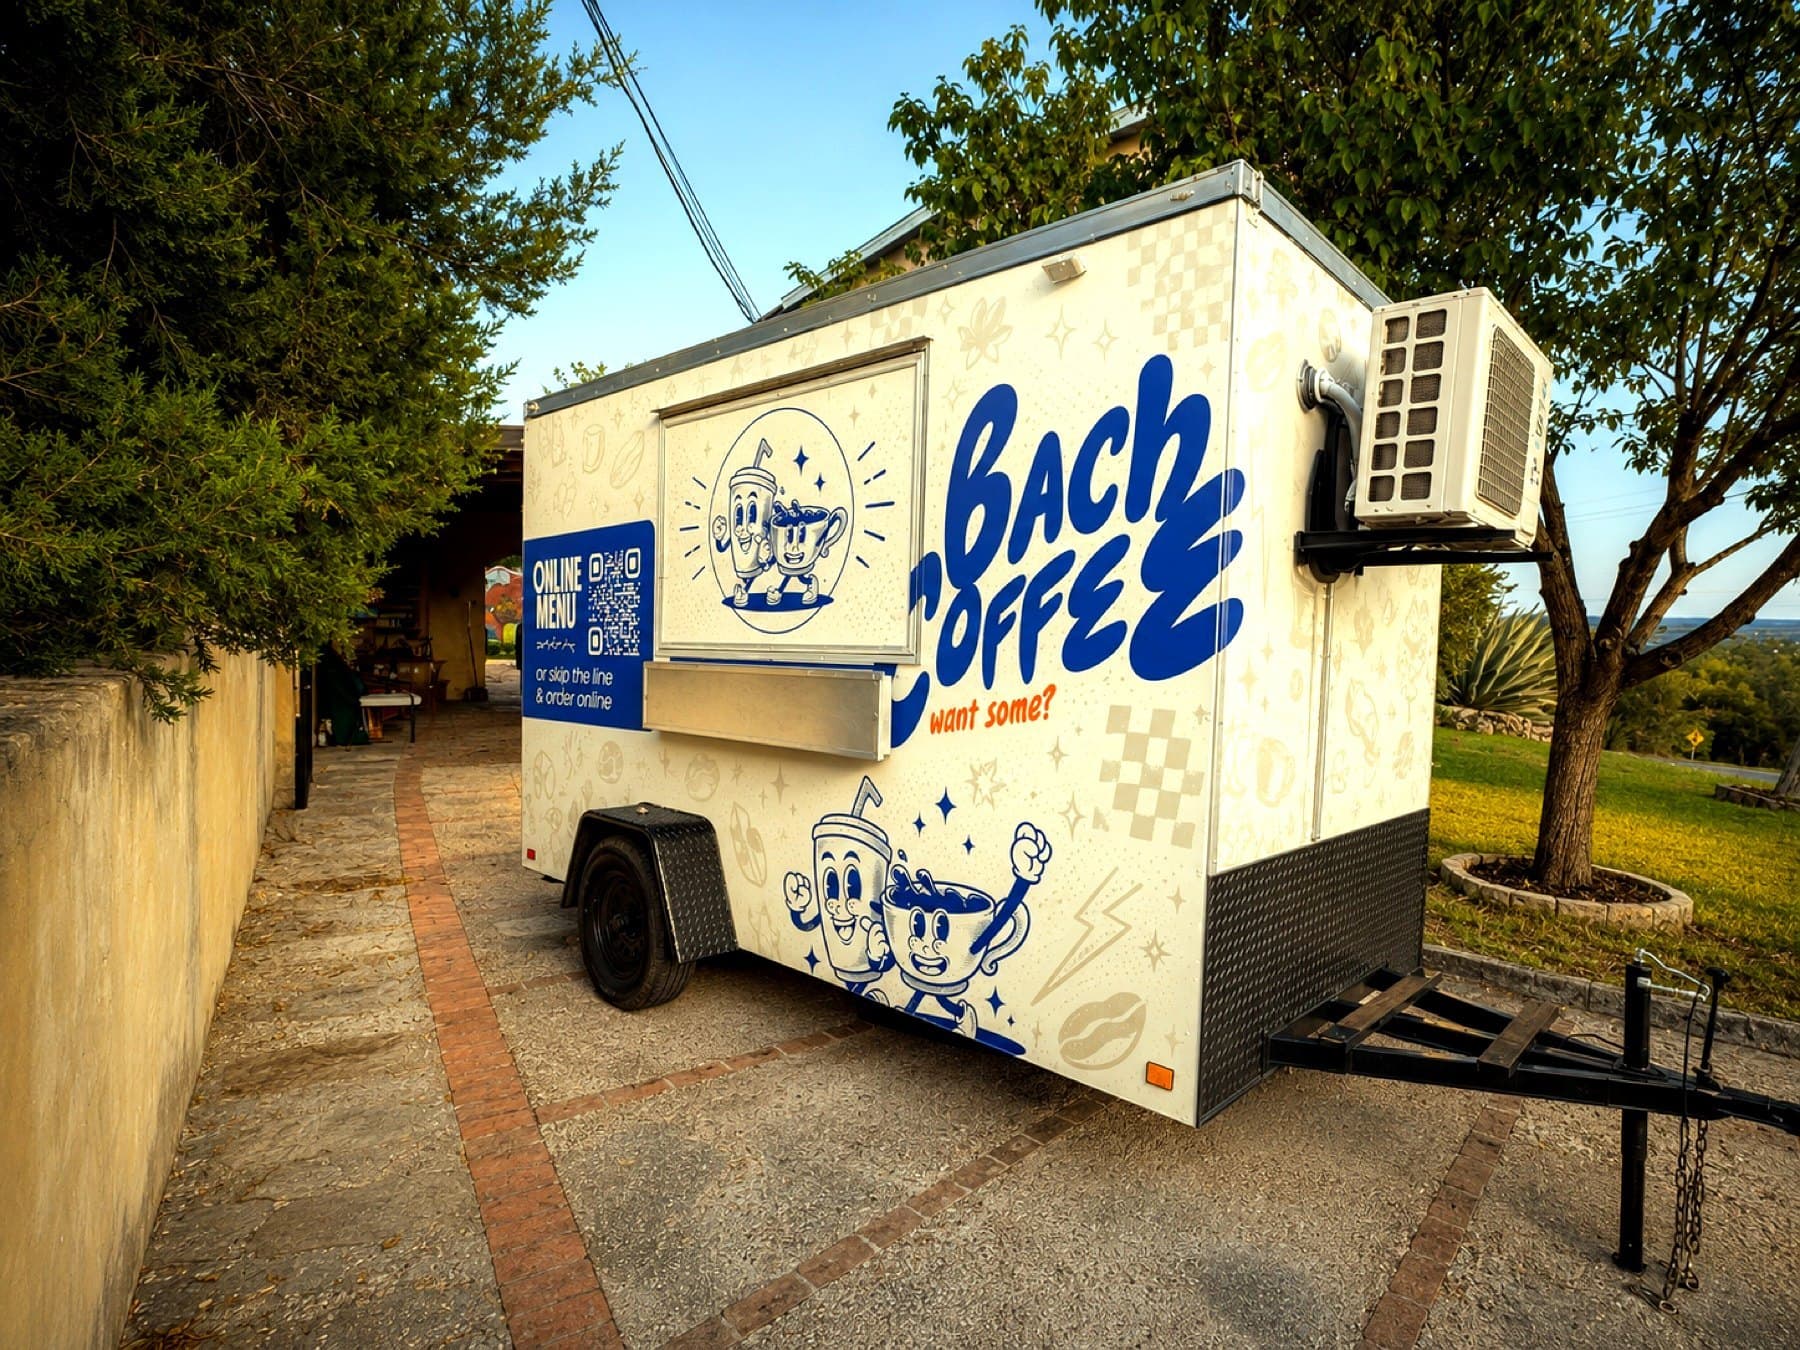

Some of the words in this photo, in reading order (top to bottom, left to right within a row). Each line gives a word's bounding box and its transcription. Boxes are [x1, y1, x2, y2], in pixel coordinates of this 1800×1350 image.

[533, 556, 582, 593] ONLINE
[536, 593, 576, 629] MENU
[535, 668, 547, 681] or
[548, 666, 570, 685] skip
[572, 667, 590, 685] the
[592, 667, 613, 686] line
[535, 687, 543, 704] &
[546, 687, 574, 706] order
[577, 691, 612, 710] online
[930, 699, 979, 735] want
[984, 684, 1057, 728] some?
